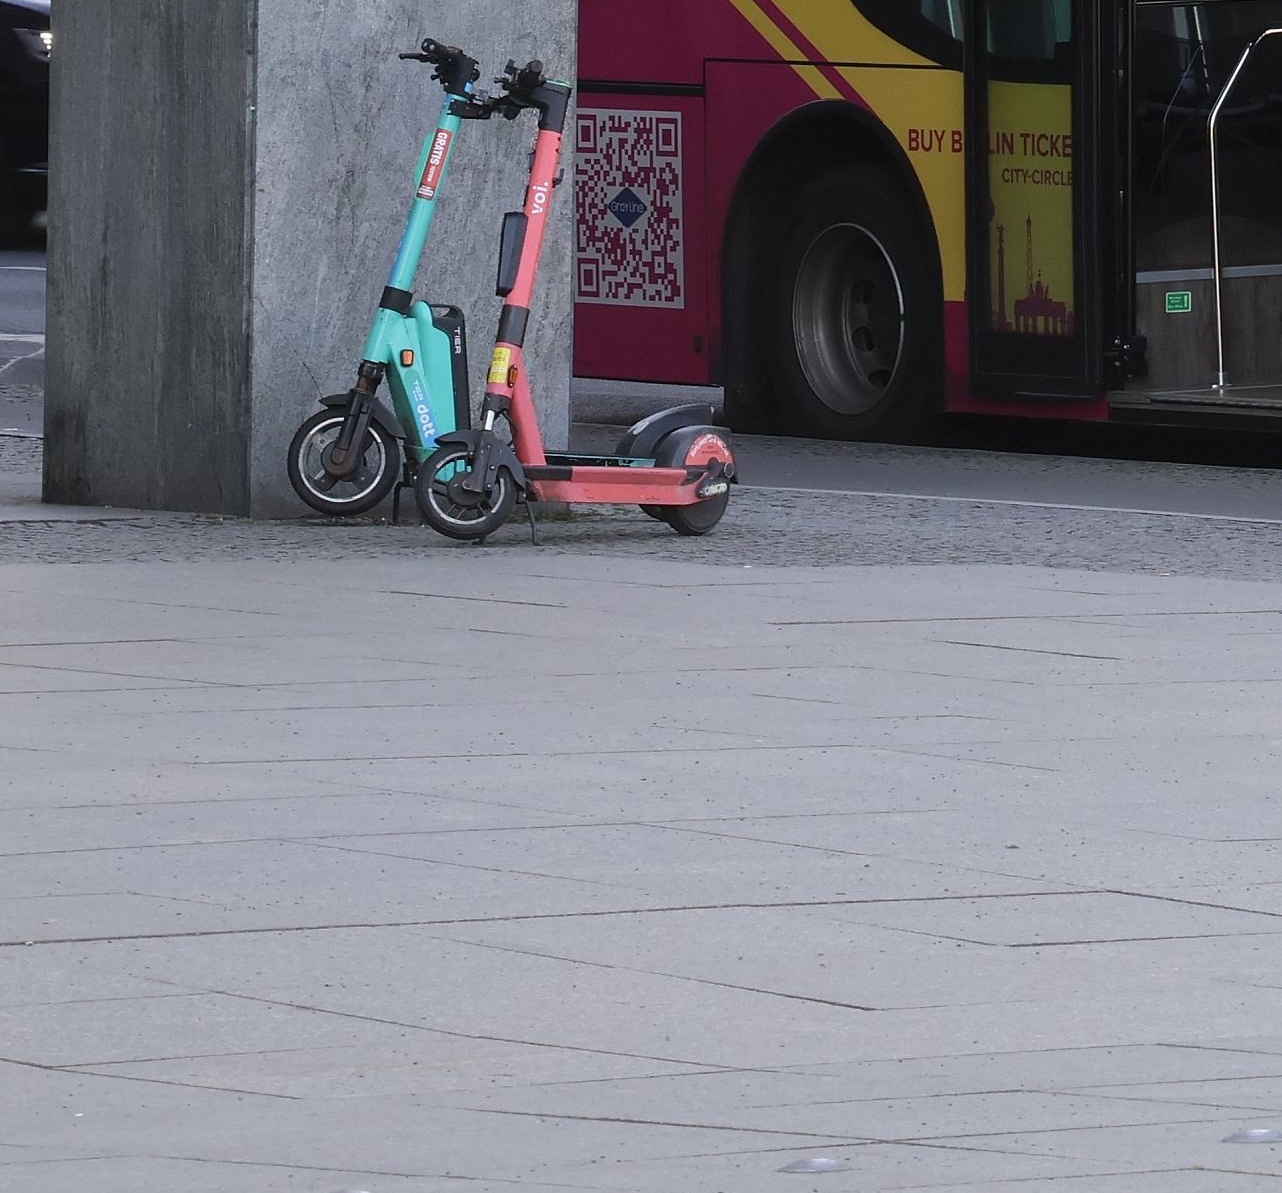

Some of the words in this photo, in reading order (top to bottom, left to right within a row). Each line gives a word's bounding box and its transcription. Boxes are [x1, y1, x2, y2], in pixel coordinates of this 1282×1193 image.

[429, 132, 448, 166] GRATIS
[908, 128, 946, 153] BUY
[453, 326, 462, 355] TIER
